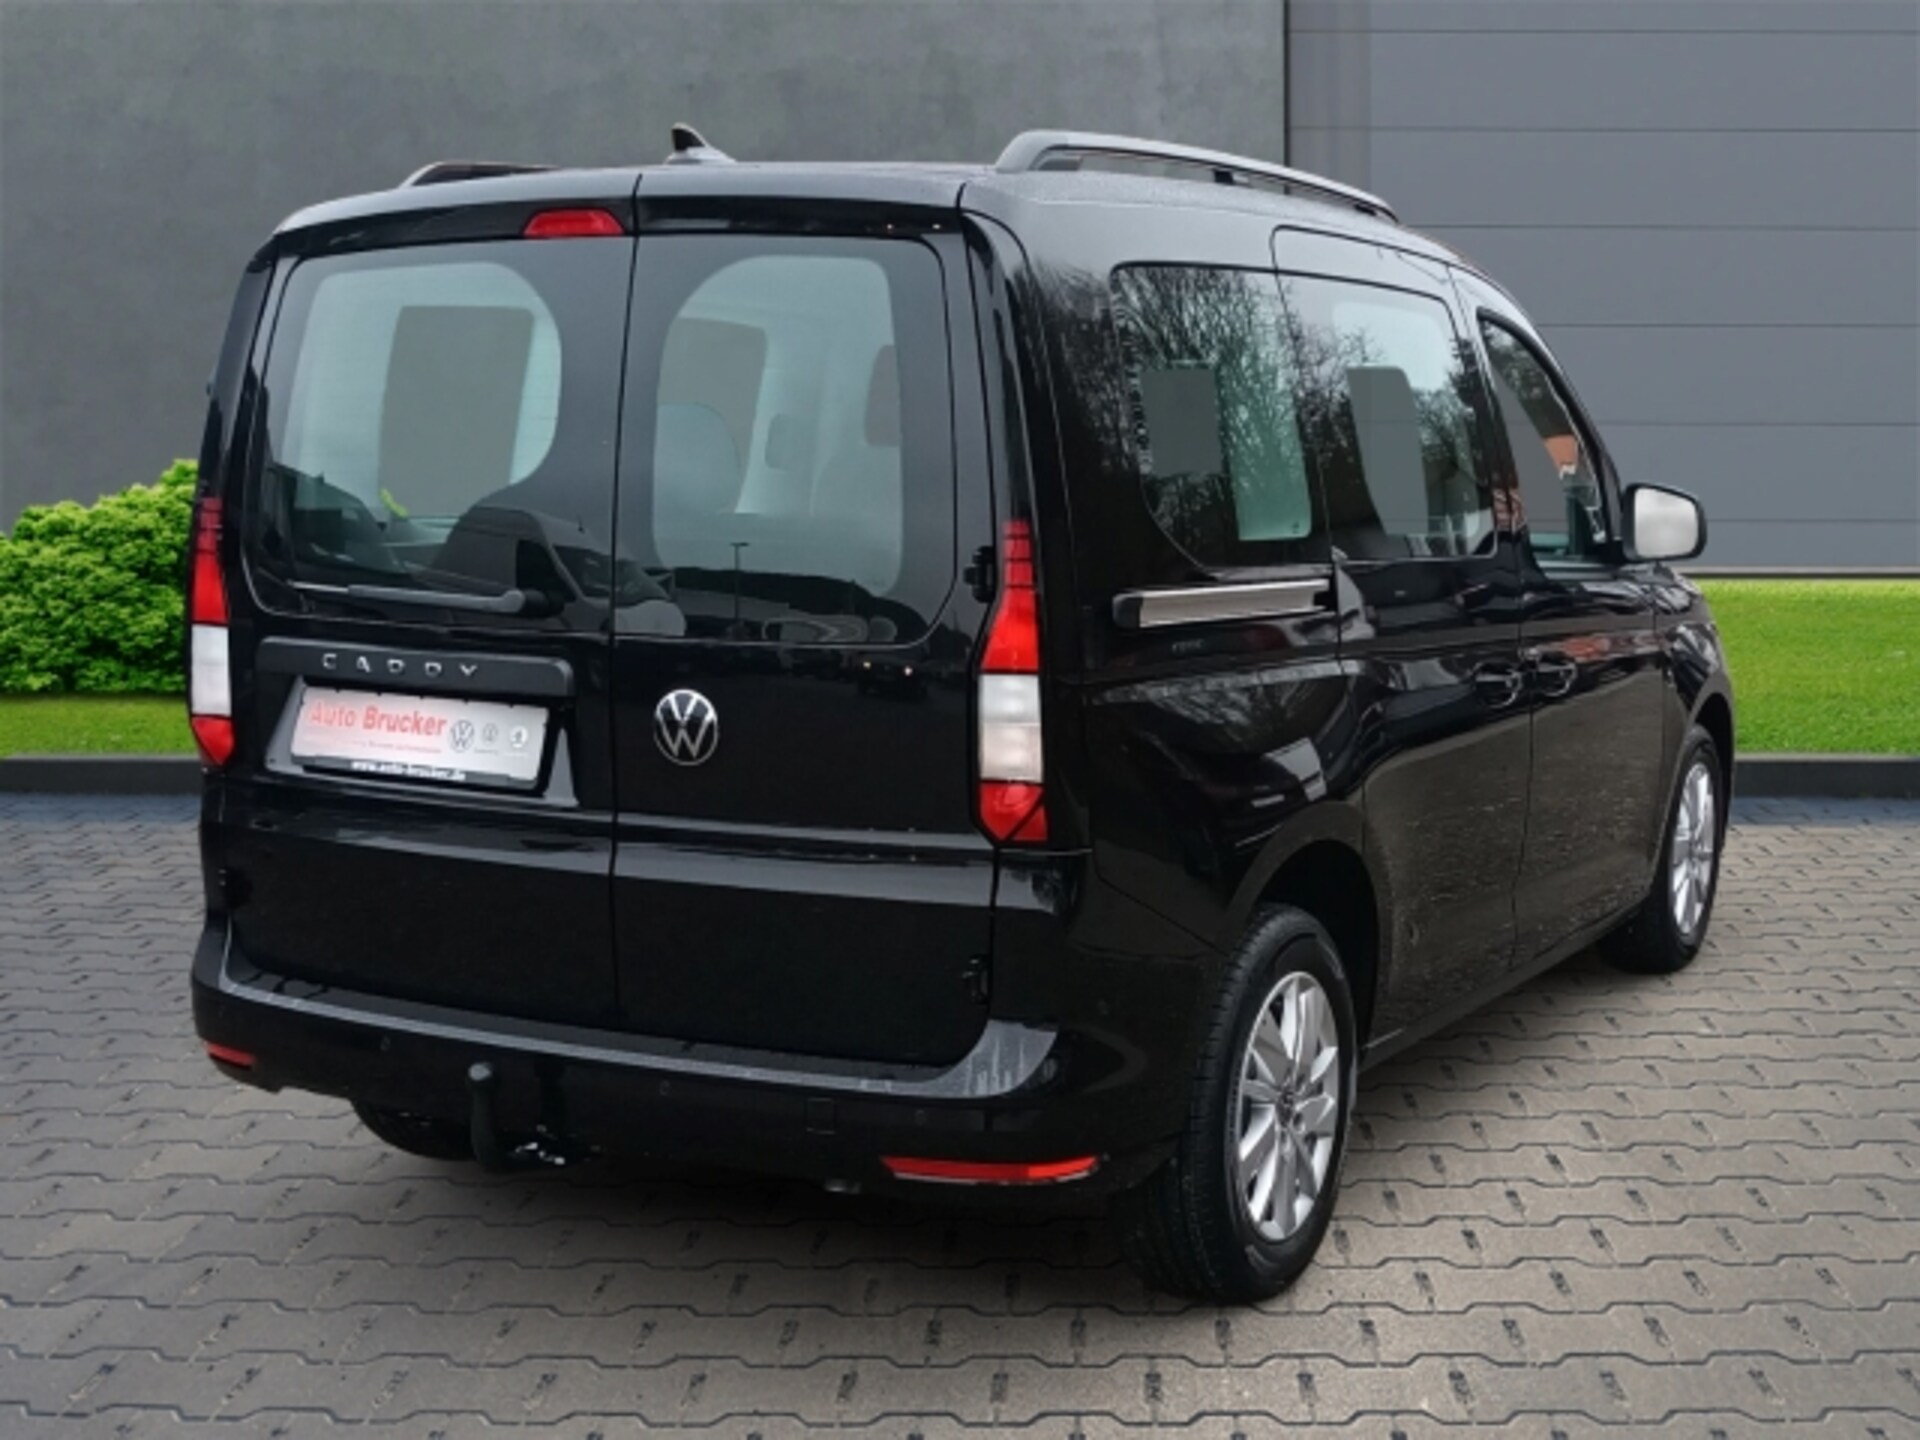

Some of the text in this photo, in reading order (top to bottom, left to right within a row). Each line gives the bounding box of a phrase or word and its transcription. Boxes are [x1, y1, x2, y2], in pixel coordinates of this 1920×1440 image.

[322, 653, 477, 677] CADDY
[311, 702, 448, 737] Auto Brucker
